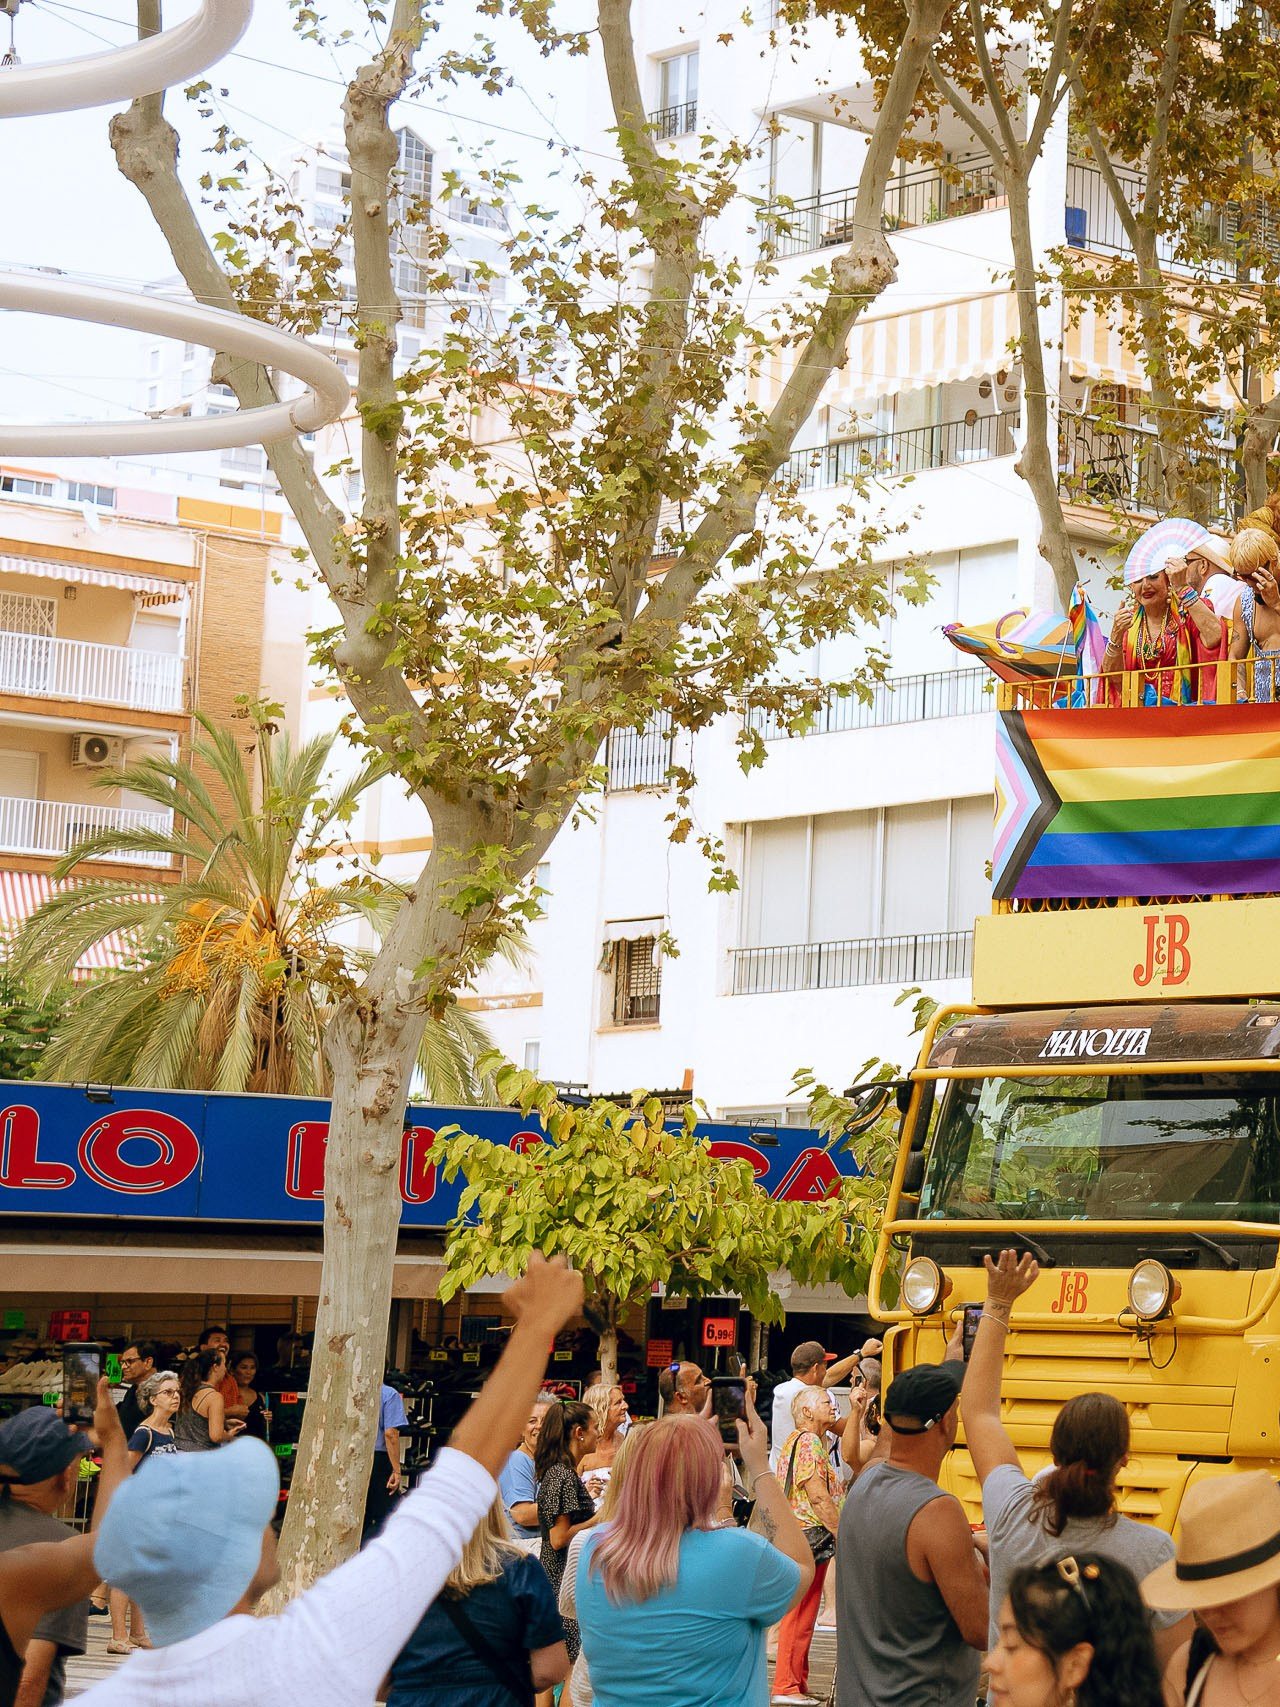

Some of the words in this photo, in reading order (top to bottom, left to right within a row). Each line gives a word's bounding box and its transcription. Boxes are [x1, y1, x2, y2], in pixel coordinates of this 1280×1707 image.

[1133, 914, 1191, 987] J&B
[1038, 1027, 1152, 1057] MANOLITA
[1051, 1271, 1089, 1314] J&B
